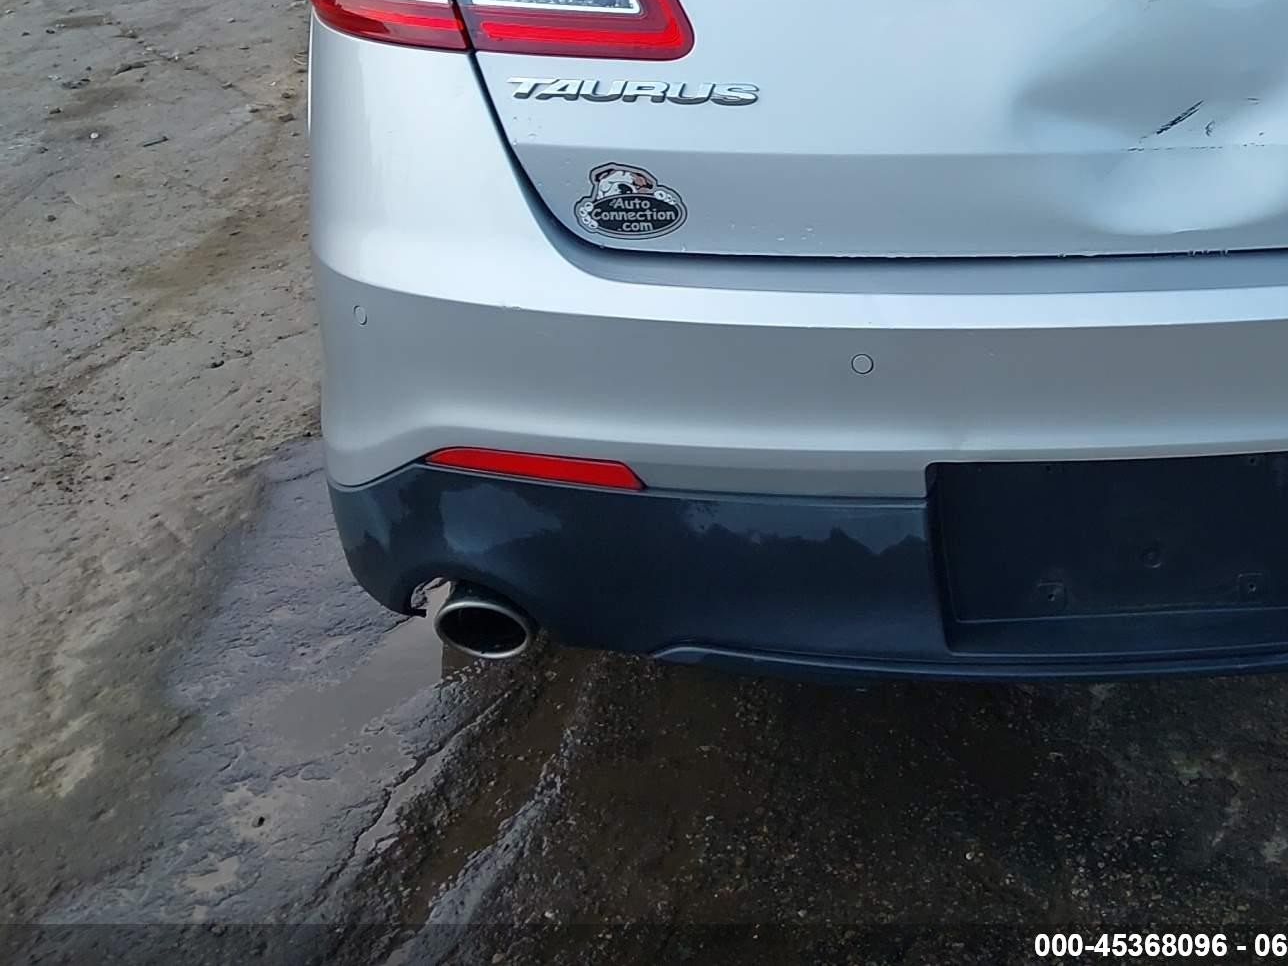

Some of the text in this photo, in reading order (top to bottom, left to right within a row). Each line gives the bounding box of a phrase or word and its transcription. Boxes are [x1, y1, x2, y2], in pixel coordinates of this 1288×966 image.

[507, 76, 760, 107] TAURUS
[591, 208, 676, 221] Connection
[617, 221, 654, 232] .com
